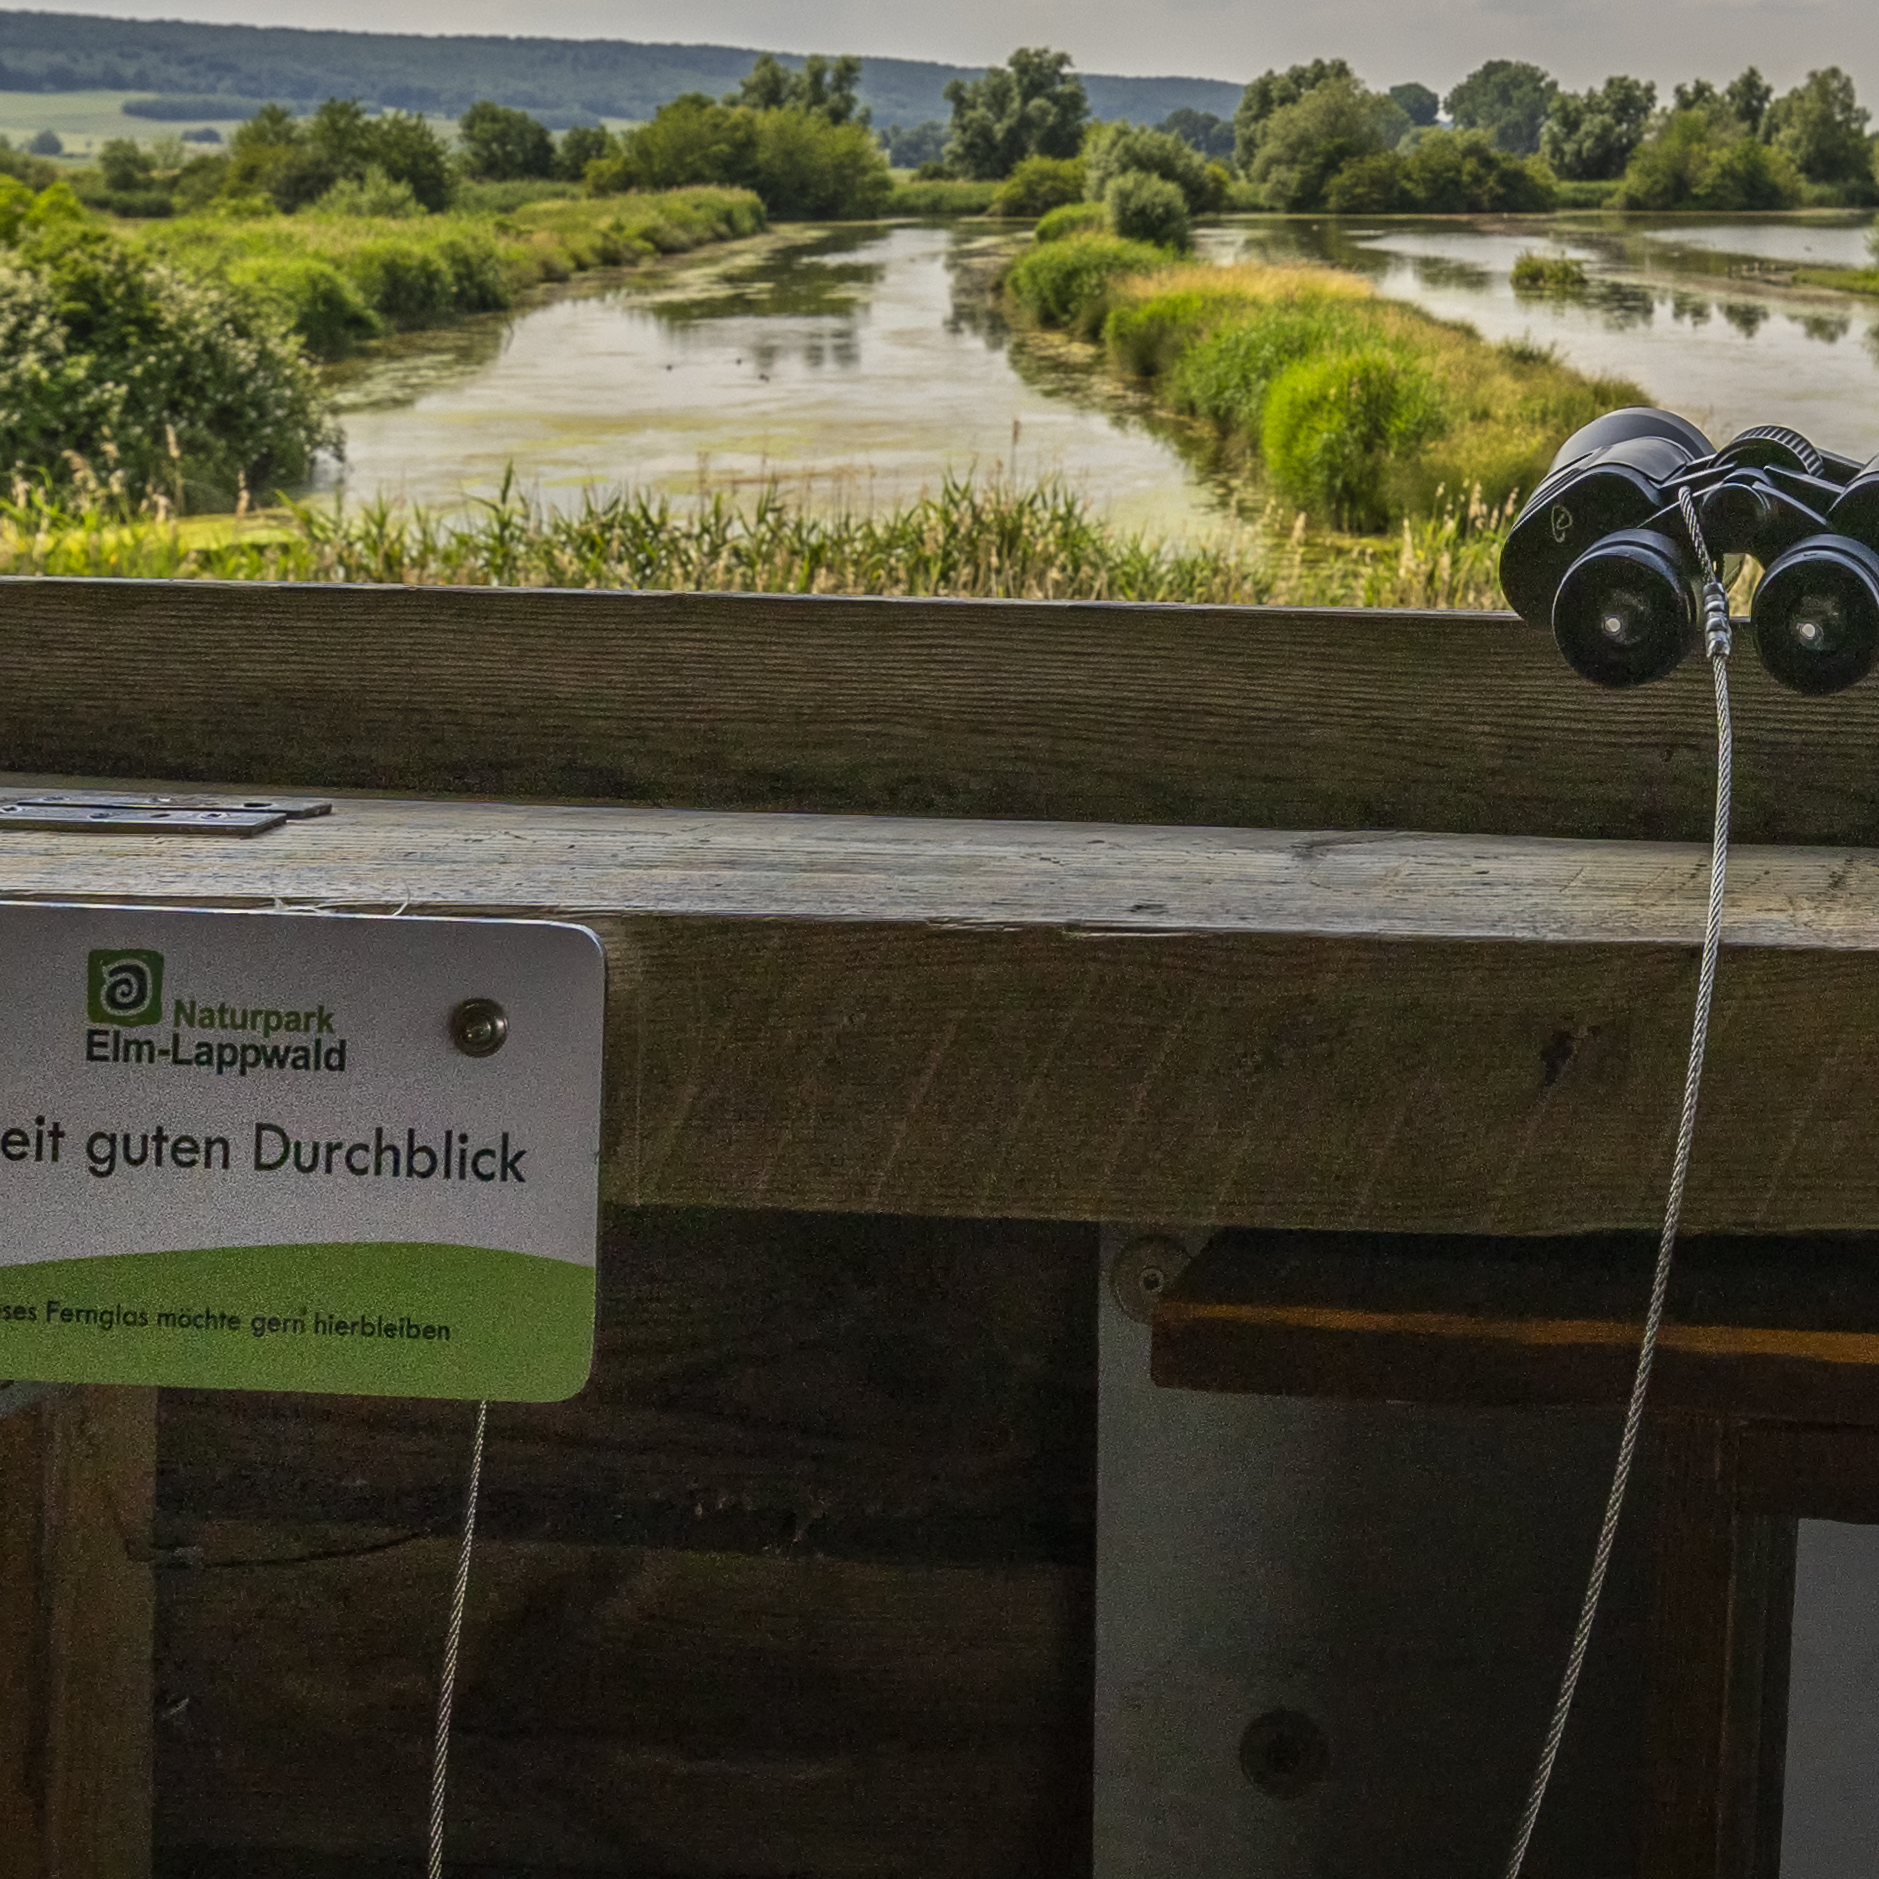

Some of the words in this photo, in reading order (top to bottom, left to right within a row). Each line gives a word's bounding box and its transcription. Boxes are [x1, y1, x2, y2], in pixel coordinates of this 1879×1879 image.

[174, 999, 335, 1038] Naturpark
[86, 1028, 347, 1076] Elm-Lappwald
[85, 1126, 230, 1178] guten
[254, 1122, 527, 1183] Durchblick
[46, 1300, 149, 1331] Fernglas
[157, 1307, 241, 1331] möchte
[251, 1313, 305, 1337] gern
[314, 1312, 451, 1341] hierbleiben
